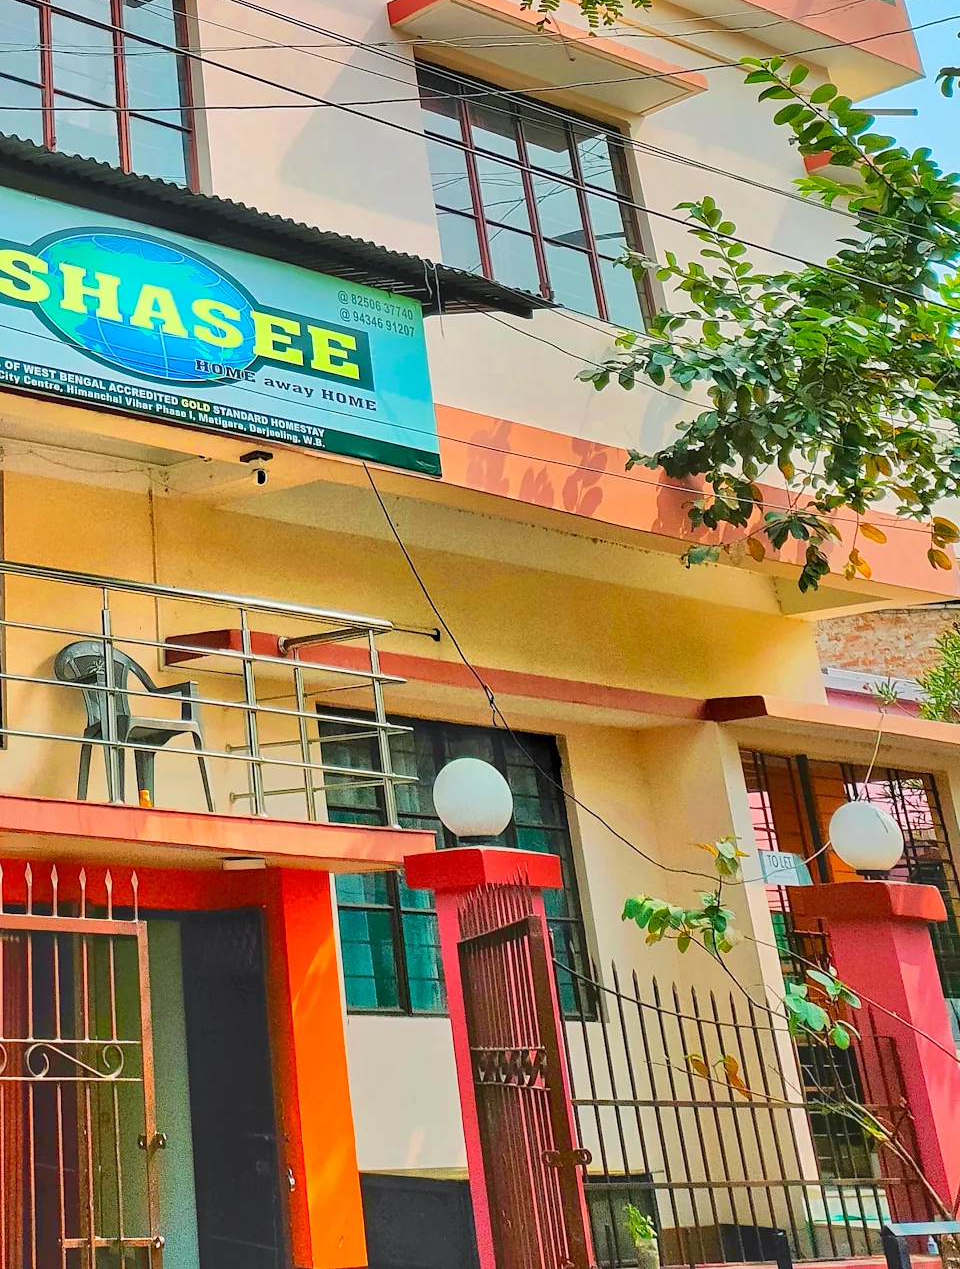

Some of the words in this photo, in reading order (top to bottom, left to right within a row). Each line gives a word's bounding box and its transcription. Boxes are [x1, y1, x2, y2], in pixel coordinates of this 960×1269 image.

[351, 293, 382, 312] 82506
[384, 302, 414, 321] 37740
[353, 310, 384, 329] 94346
[385, 319, 415, 338] 91207
[4, 360, 21, 372] OF
[23, 364, 57, 379] WEST
[59, 371, 107, 391] BENGAL
[108, 382, 179, 406] ACCREDITED
[181, 398, 211, 413] GOLD
[212, 405, 269, 426] STANDARD
[270, 417, 325, 438] HOMESTAY
[194, 359, 256, 383] HOME
[263, 377, 315, 399] away
[321, 388, 377, 412] HOME
[23, 375, 64, 393] Centre,
[66, 383, 123, 405] Himanchal
[125, 395, 154, 411] Vihar
[155, 403, 187, 418] Phase
[198, 412, 247, 432] Matigara,
[249, 423, 301, 444] Darjeeling,
[303, 434, 326, 448] W.B.
[767, 854, 779, 868] TO
[779, 856, 793, 869] LET
